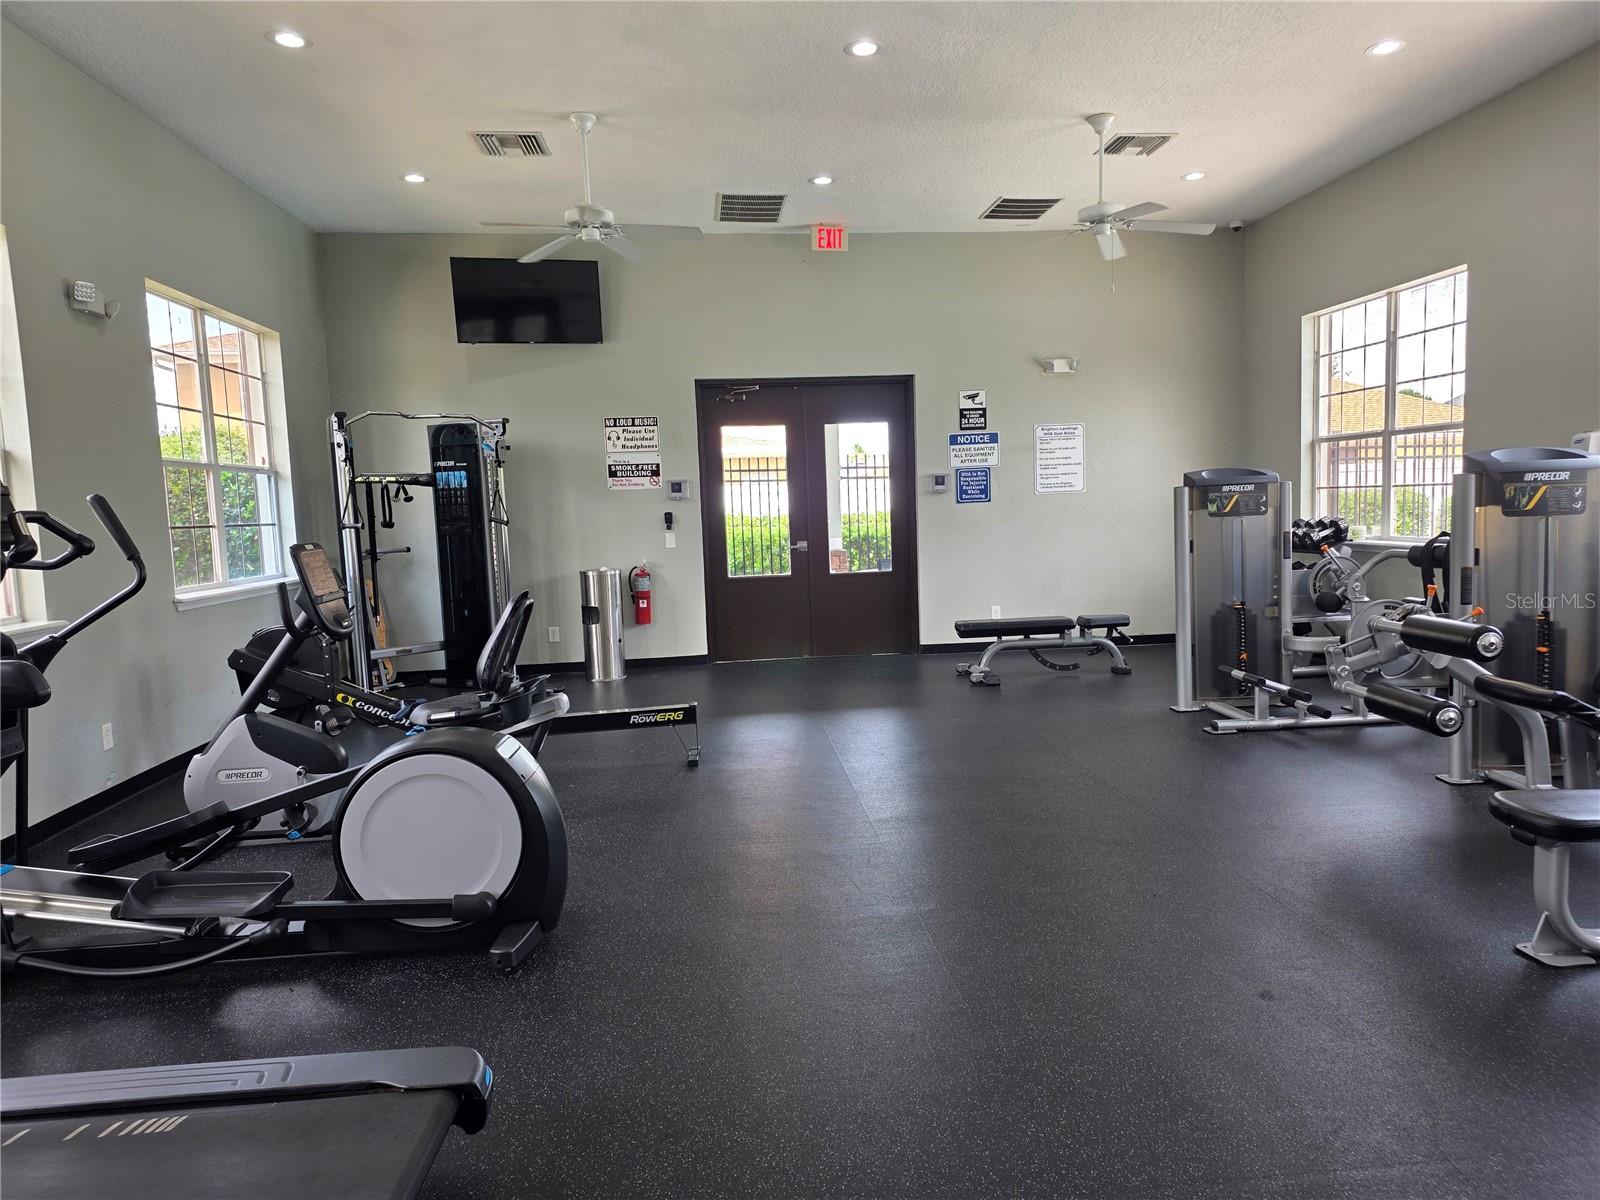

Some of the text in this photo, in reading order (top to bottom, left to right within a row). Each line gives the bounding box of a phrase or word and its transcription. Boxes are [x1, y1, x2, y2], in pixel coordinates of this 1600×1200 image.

[818, 228, 843, 249] EXIT
[957, 434, 990, 444] NOTICE
[1531, 471, 1570, 480] PRECOR
